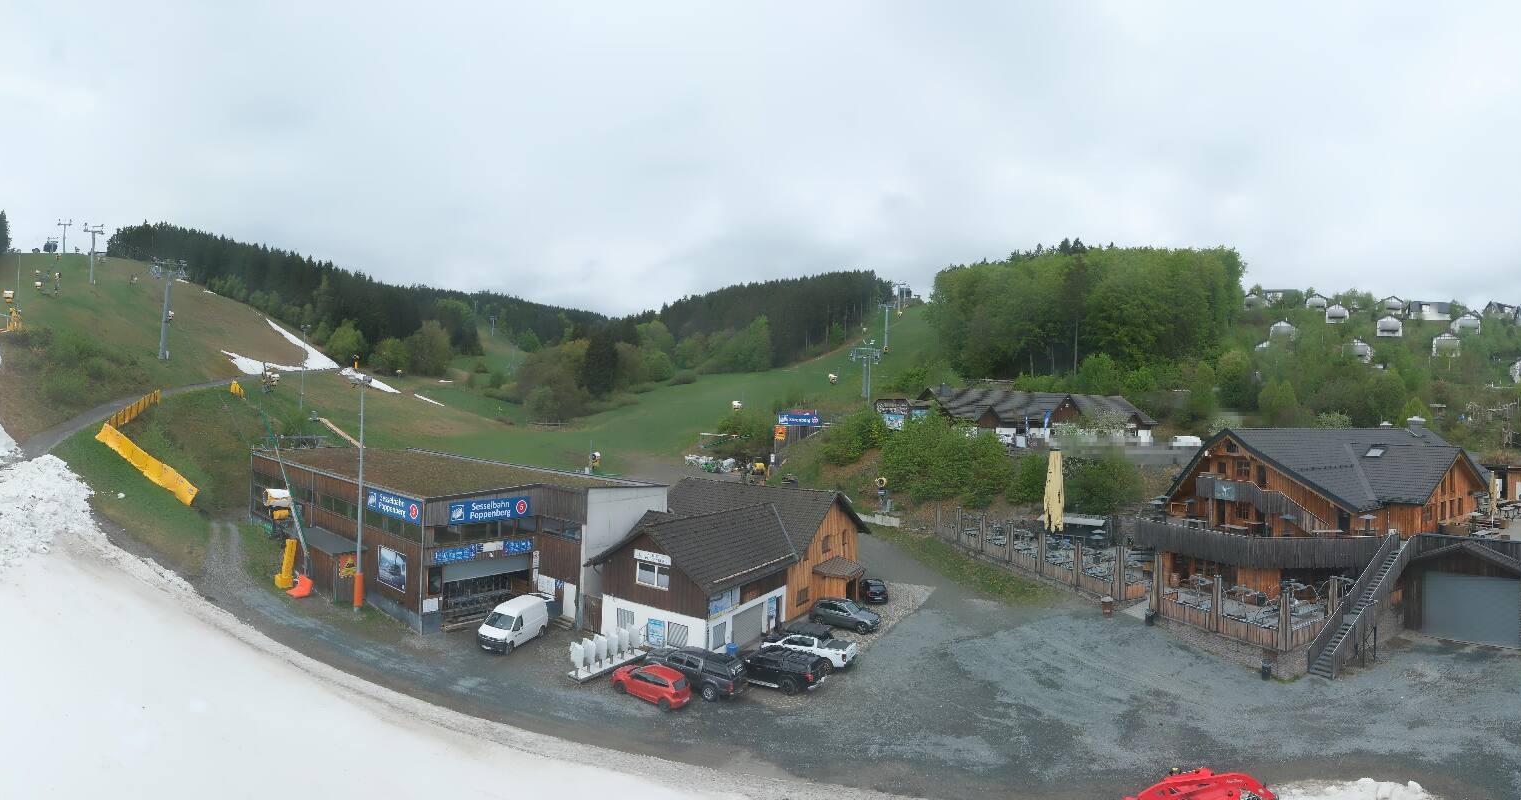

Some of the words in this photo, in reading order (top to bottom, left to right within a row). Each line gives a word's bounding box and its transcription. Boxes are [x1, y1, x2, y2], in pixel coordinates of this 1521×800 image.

[379, 493, 405, 507] Sesselbahn
[471, 500, 510, 511] Sesselbahn
[378, 501, 406, 519] Poppenberg
[470, 509, 511, 520] Poppenberg
